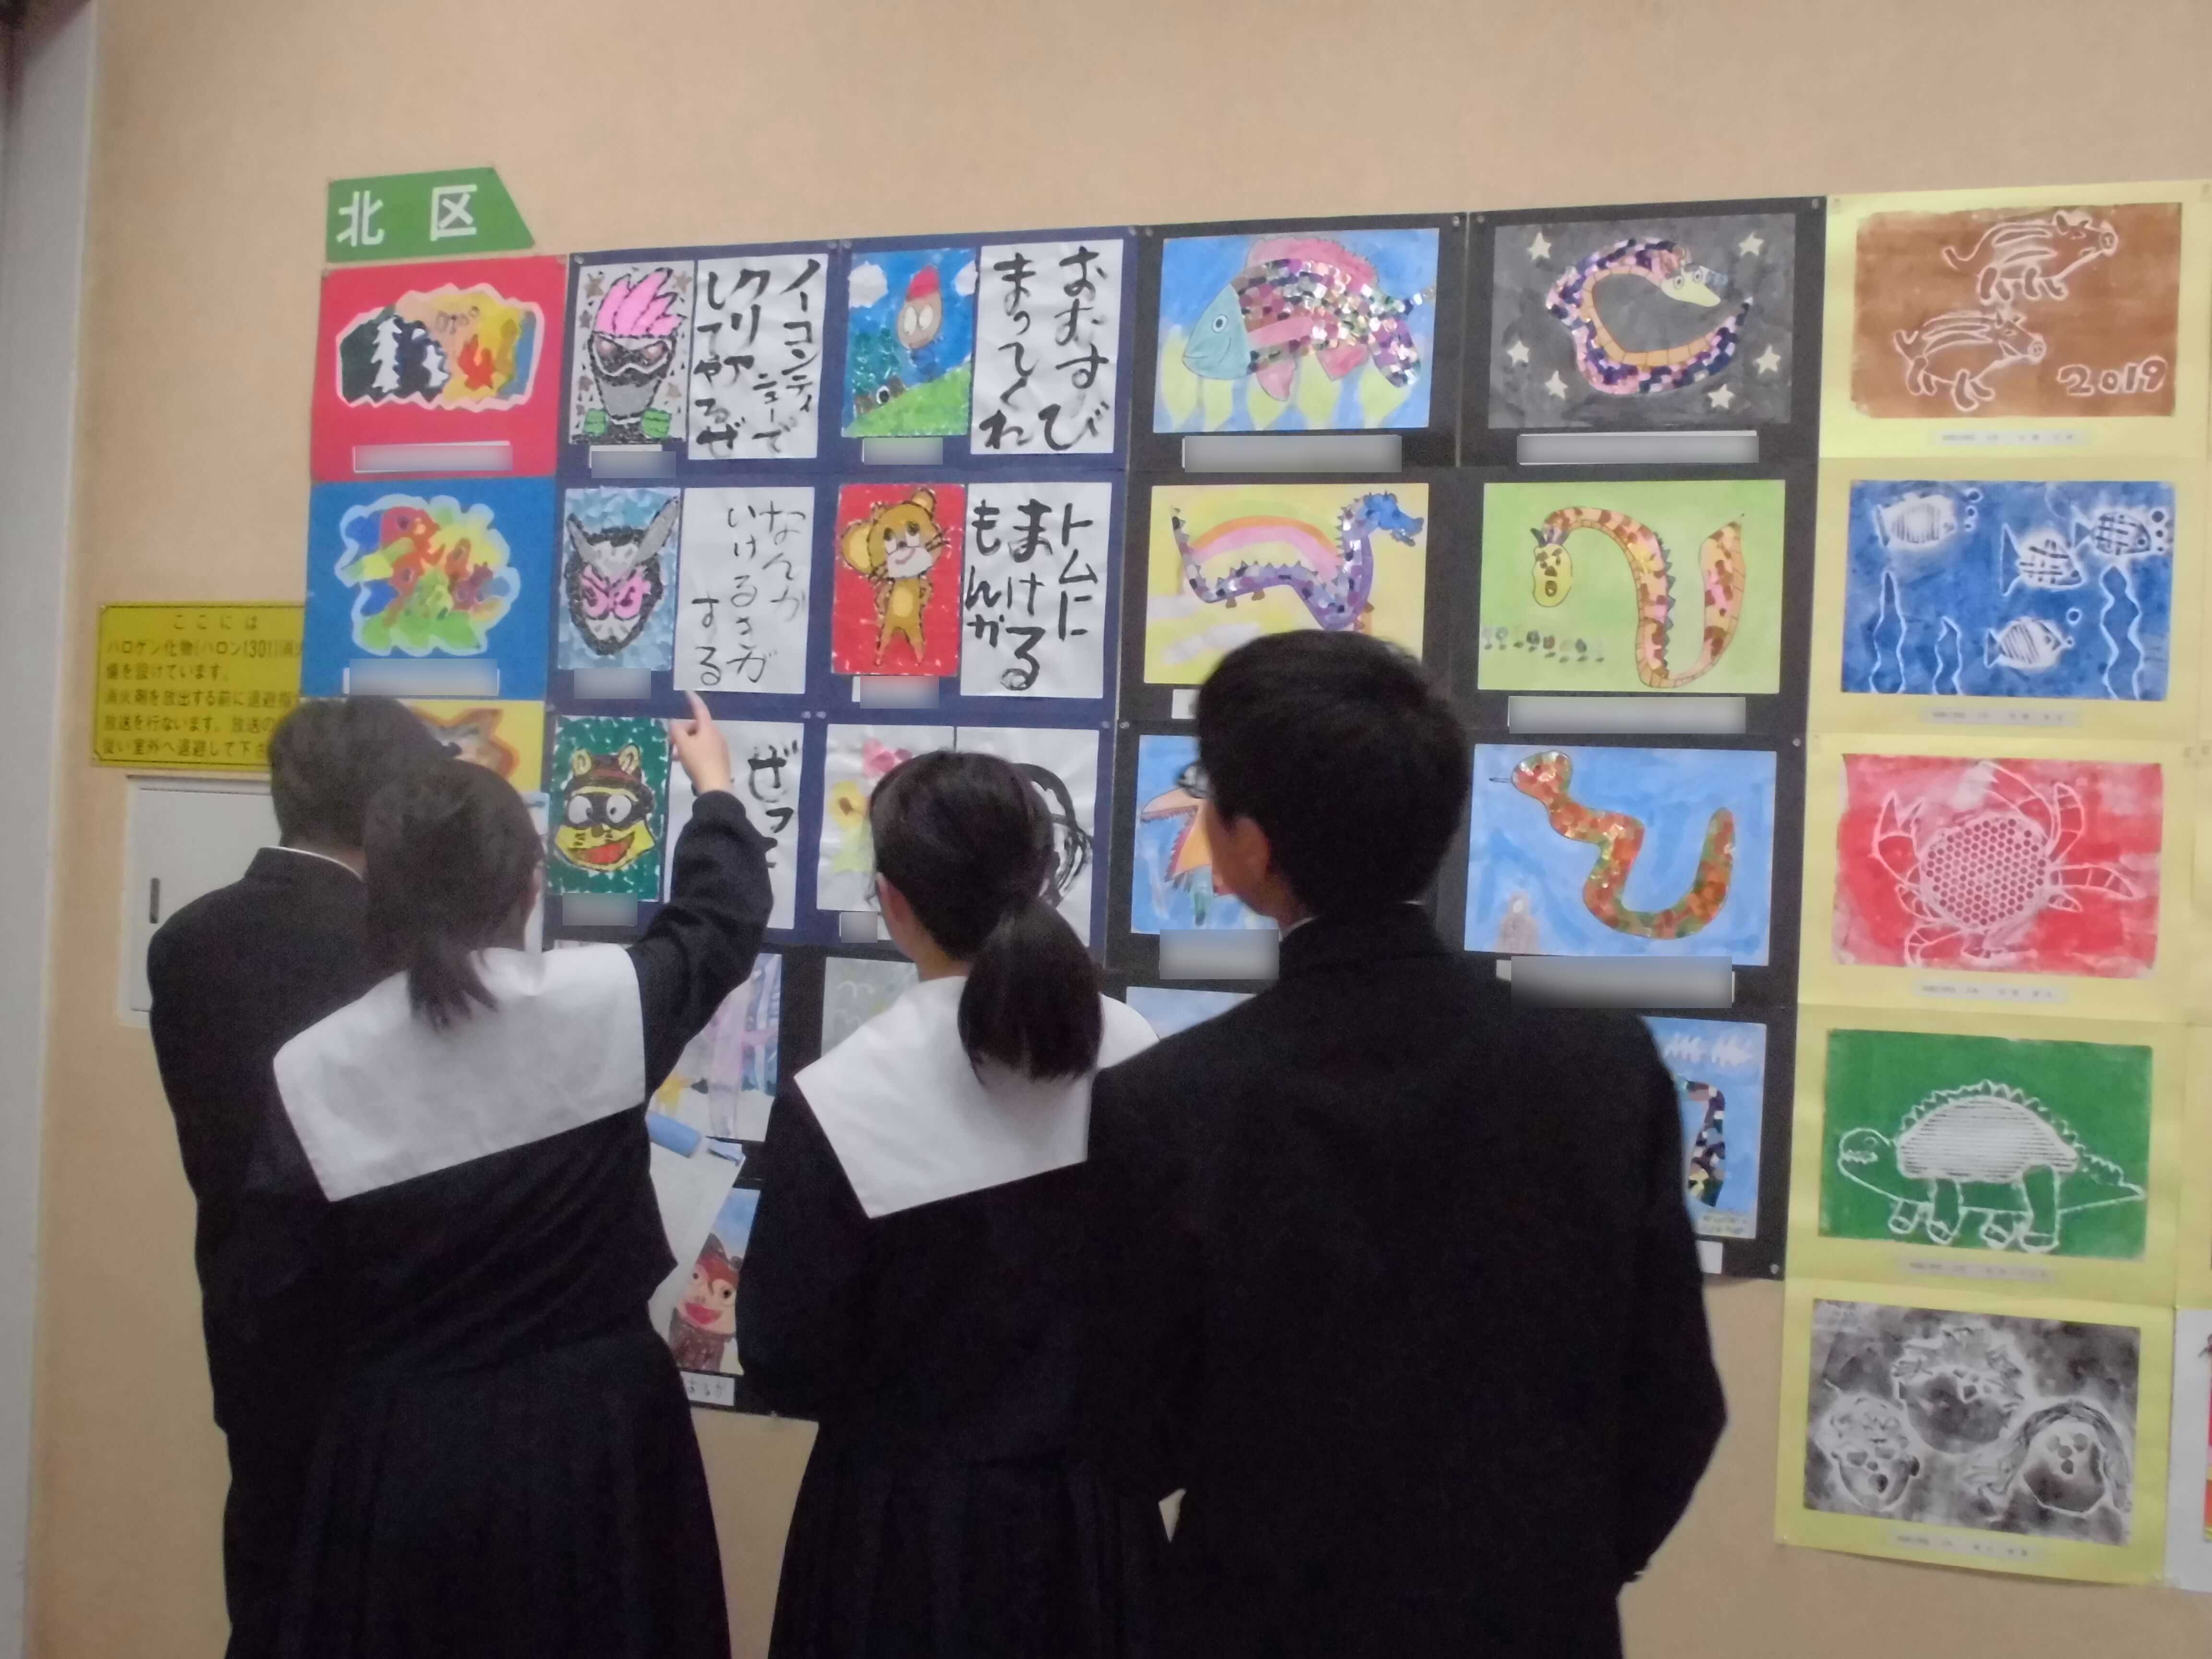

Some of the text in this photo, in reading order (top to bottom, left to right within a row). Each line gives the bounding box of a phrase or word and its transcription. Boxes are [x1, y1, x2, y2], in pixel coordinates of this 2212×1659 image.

[336, 184, 478, 247] 北区
[2056, 356, 2168, 397] 2019
[1000, 498, 1053, 690] まける
[174, 614, 258, 630] ここには
